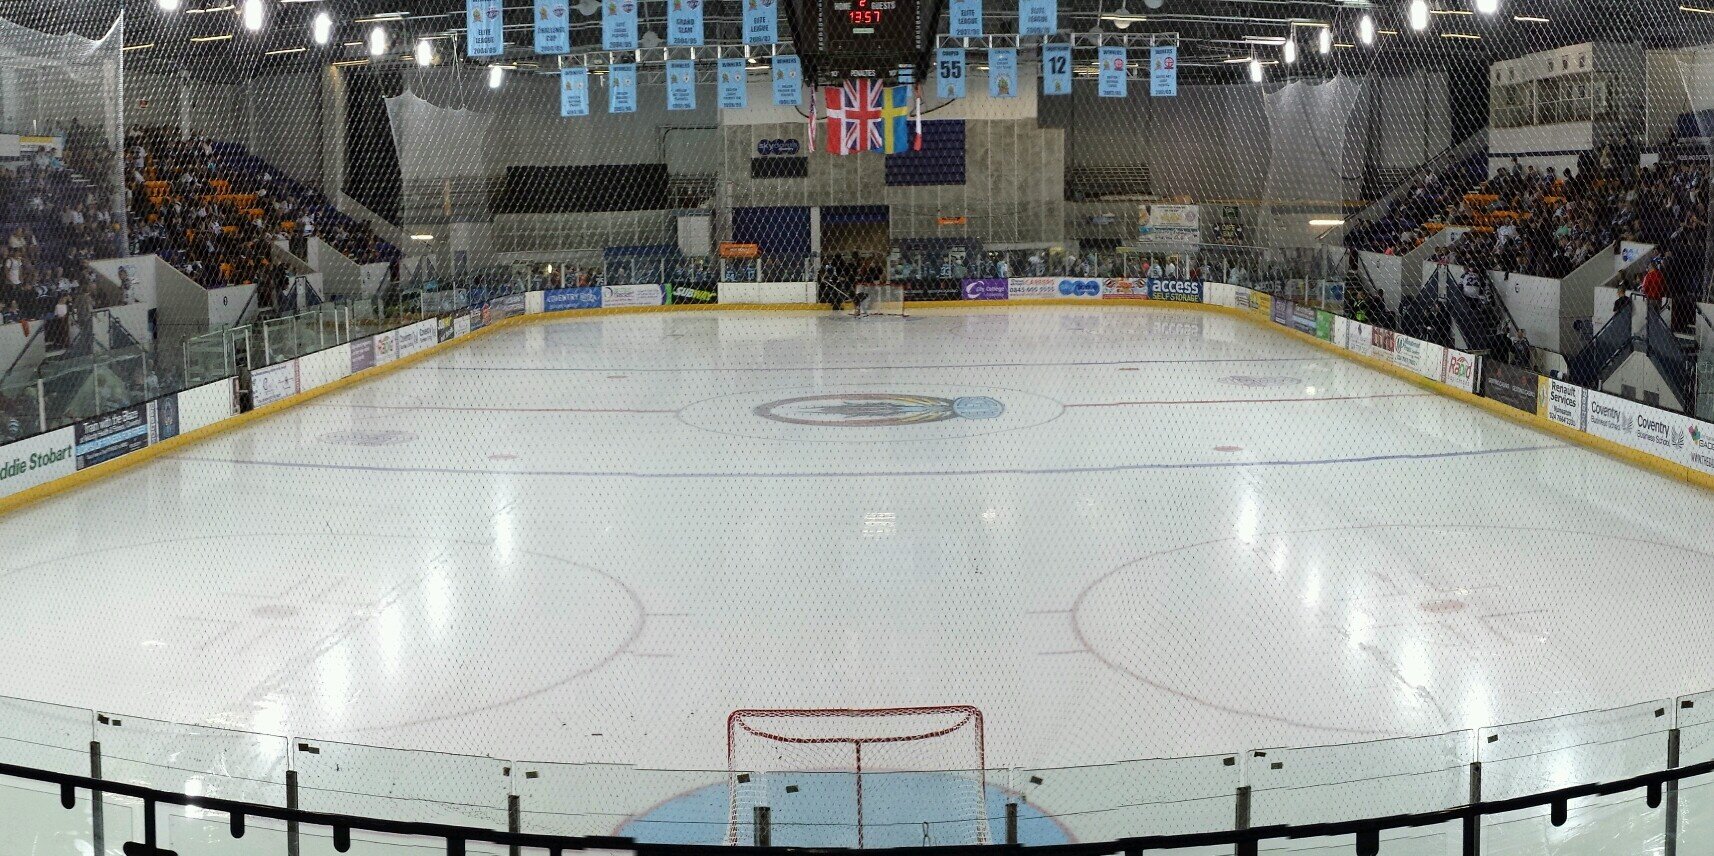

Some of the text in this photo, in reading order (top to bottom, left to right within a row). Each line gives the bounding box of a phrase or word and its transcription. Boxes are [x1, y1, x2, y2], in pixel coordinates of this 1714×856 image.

[834, 2, 852, 10] HOME
[871, 1, 896, 9] GUESTS
[850, 69, 876, 77] PENALTIES
[940, 60, 962, 78] 55
[1049, 56, 1067, 74] 12
[1152, 280, 1199, 294] access
[1551, 381, 1576, 397] Renault
[1550, 391, 1577, 408] Services
[1591, 401, 1621, 423] Coventry
[83, 410, 139, 434] Train with the Blaze
[1590, 415, 1621, 431] Business School
[1637, 414, 1670, 439] Coventry
[1637, 429, 1671, 447] Business School
[30, 445, 72, 470] Stobart
